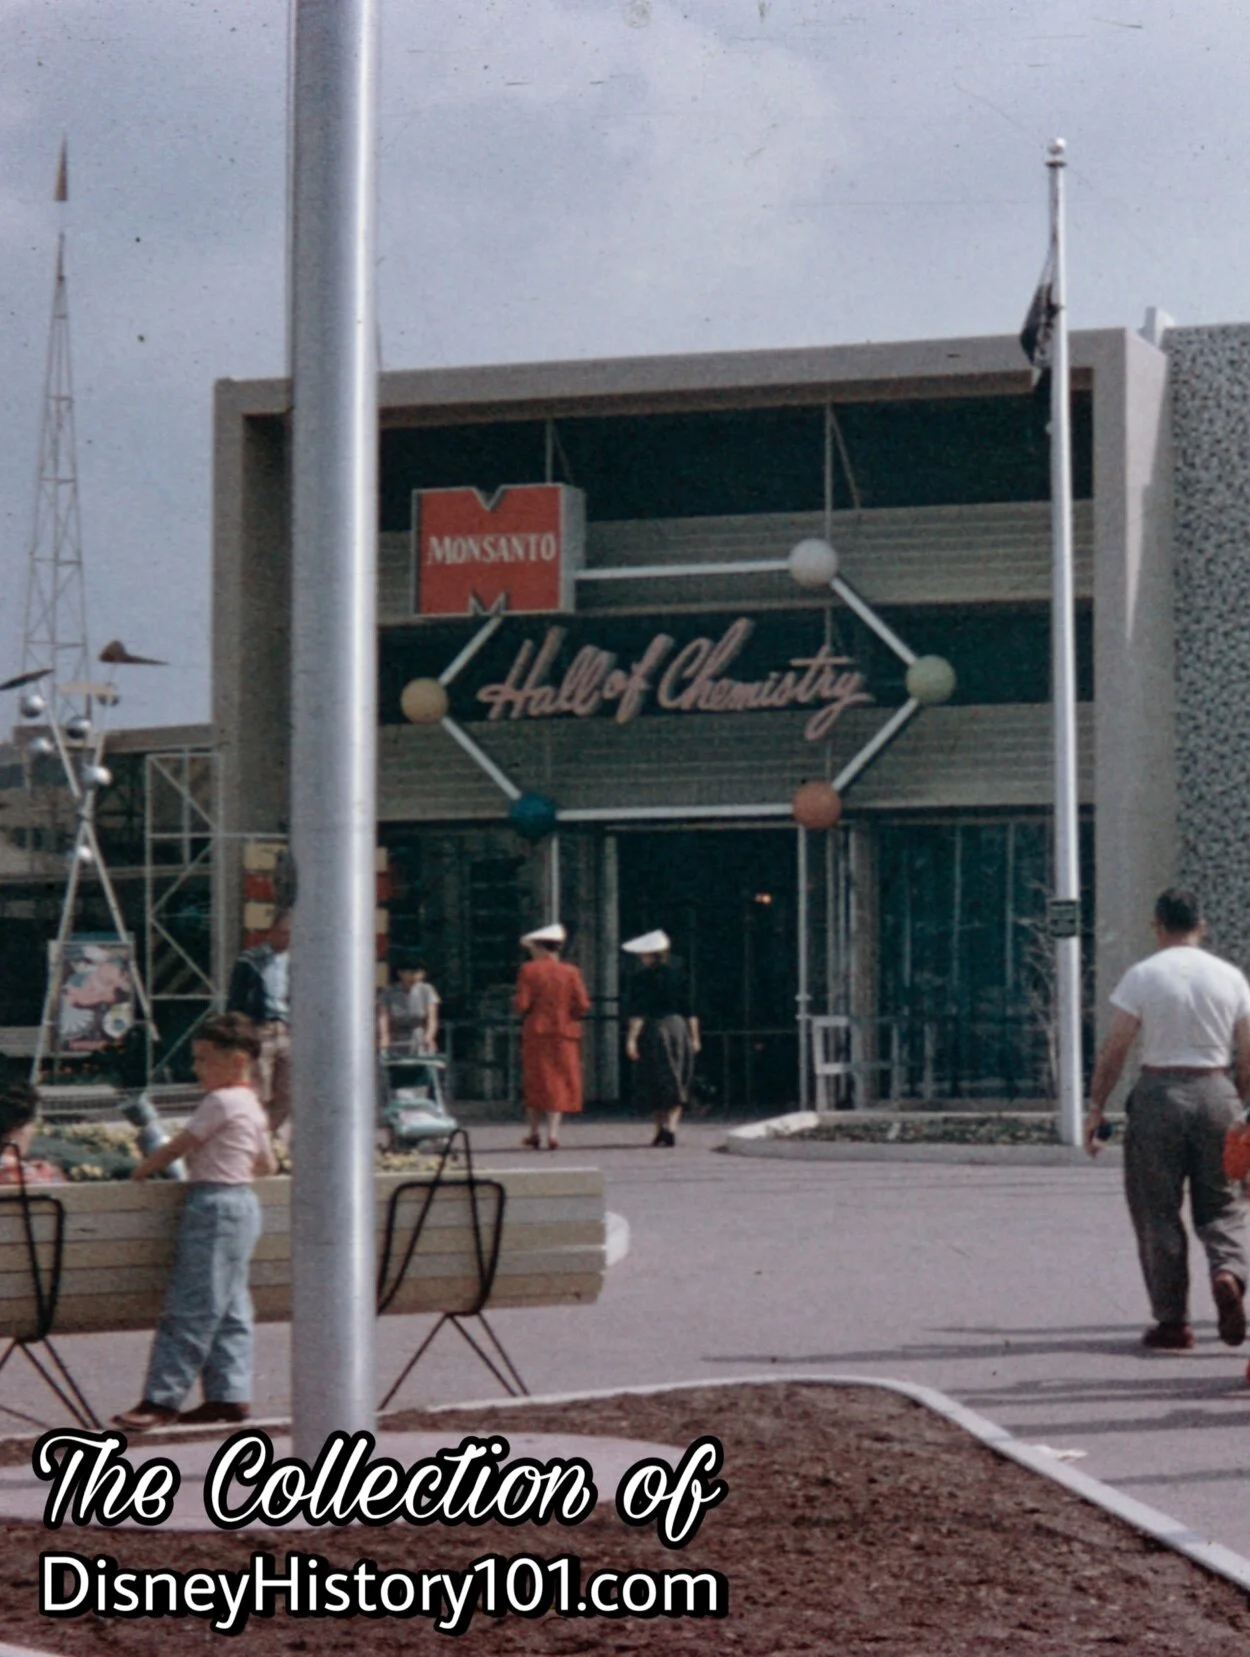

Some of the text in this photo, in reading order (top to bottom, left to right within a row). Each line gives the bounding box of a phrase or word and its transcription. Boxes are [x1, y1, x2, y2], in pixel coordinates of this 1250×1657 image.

[425, 532, 557, 566] MONSANTO
[477, 617, 877, 742] Hall of Chemistry
